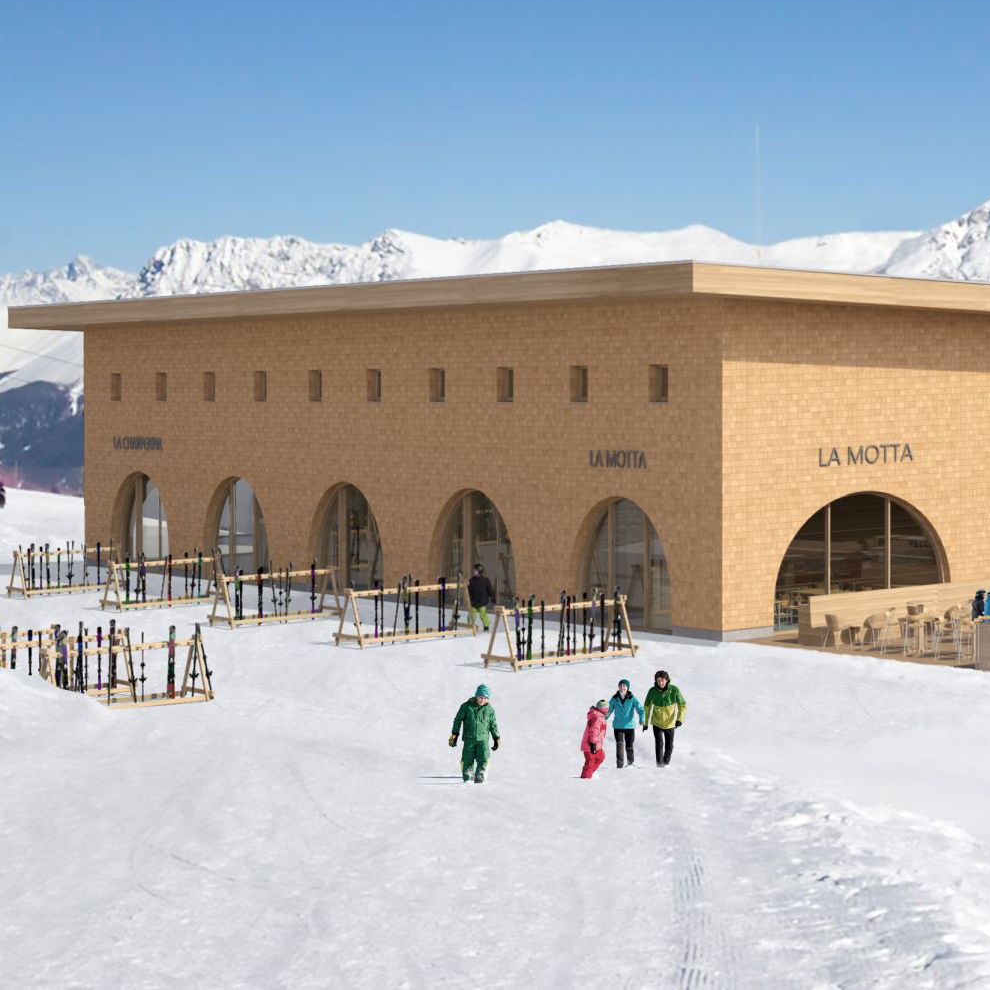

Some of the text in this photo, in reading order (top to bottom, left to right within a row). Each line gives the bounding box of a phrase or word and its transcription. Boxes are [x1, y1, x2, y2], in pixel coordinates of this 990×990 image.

[589, 450, 647, 469] LA MOTTA
[819, 443, 913, 467] LA MOTTA
